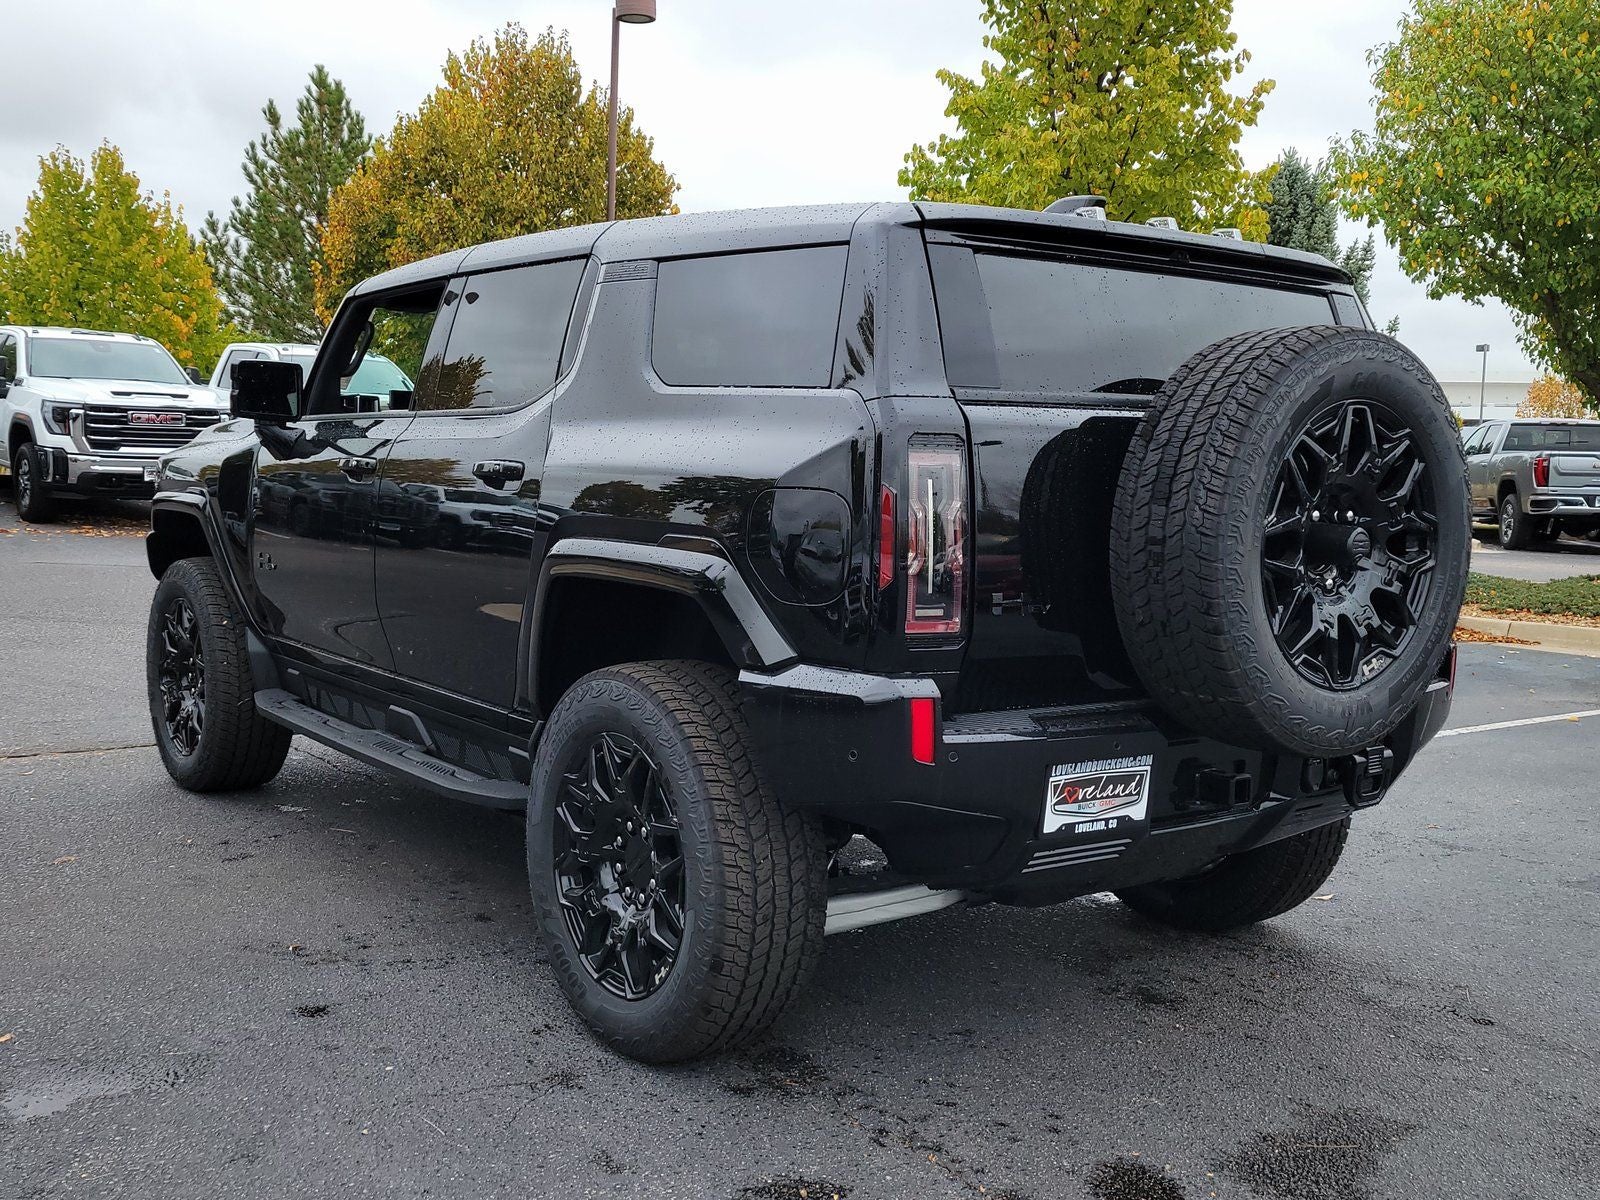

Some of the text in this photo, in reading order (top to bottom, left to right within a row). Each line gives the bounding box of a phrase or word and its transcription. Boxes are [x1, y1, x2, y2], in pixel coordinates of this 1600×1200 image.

[131, 412, 181, 424] GMC
[1051, 754, 1154, 777] LOVELANDBUICKGMC.COM
[1077, 799, 1116, 811] BUICK GMC
[1075, 819, 1118, 834] LOVELAND, CO
